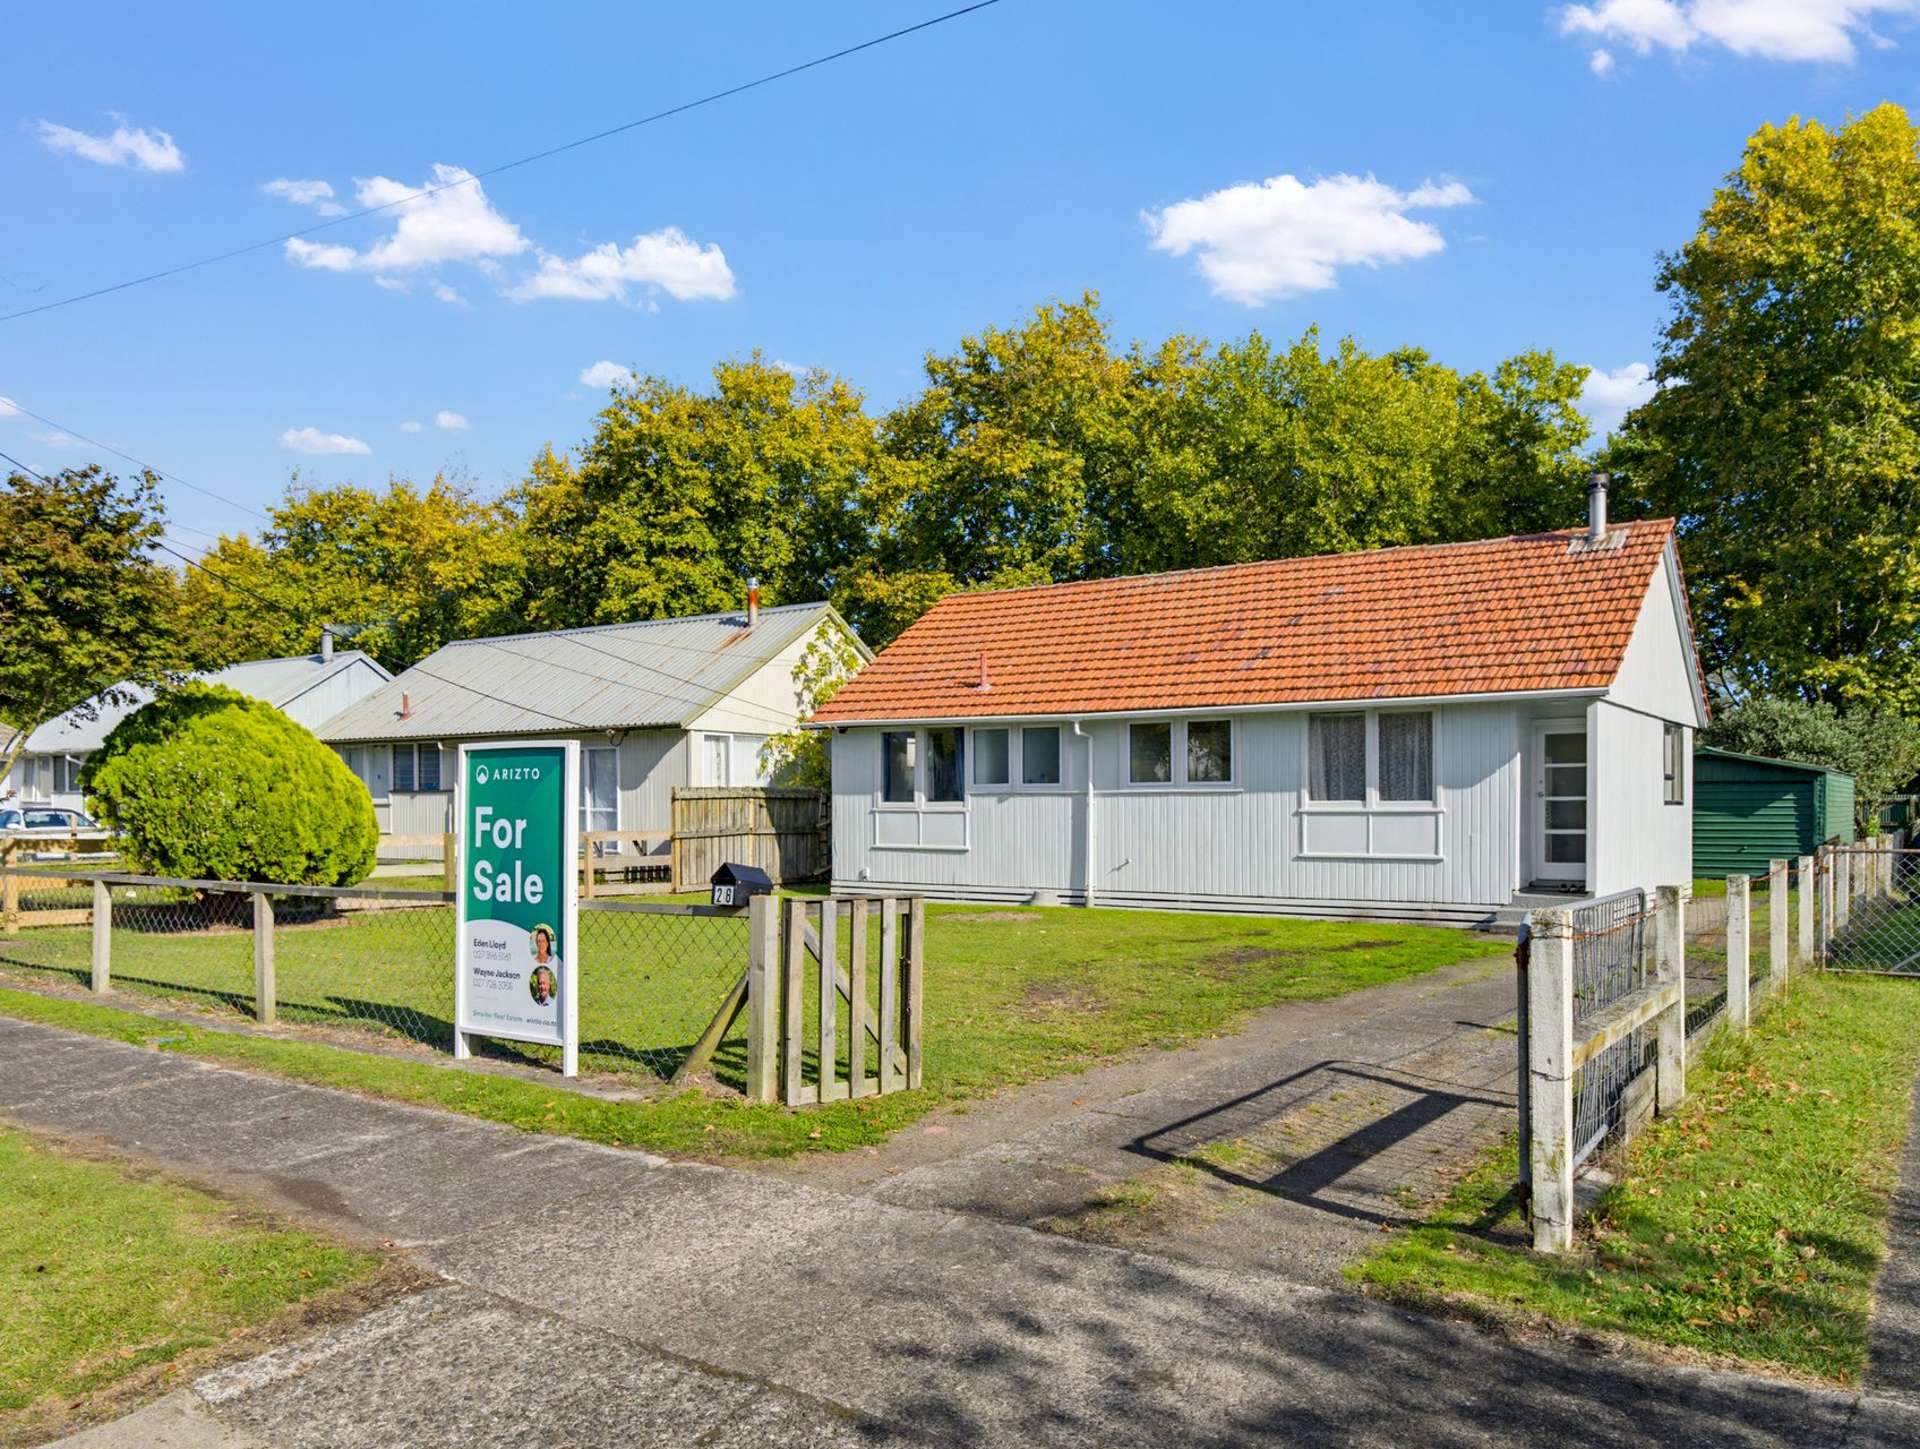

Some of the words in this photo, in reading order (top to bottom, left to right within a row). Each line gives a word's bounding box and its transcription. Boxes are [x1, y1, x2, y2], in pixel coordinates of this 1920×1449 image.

[492, 767, 540, 780] ARIZTO
[475, 806, 527, 849] For
[473, 860, 543, 904] Sale
[473, 938, 488, 948] Eden
[489, 939, 506, 951] Lloyd
[473, 967, 495, 978] Wayne
[495, 969, 521, 980] Jackson
